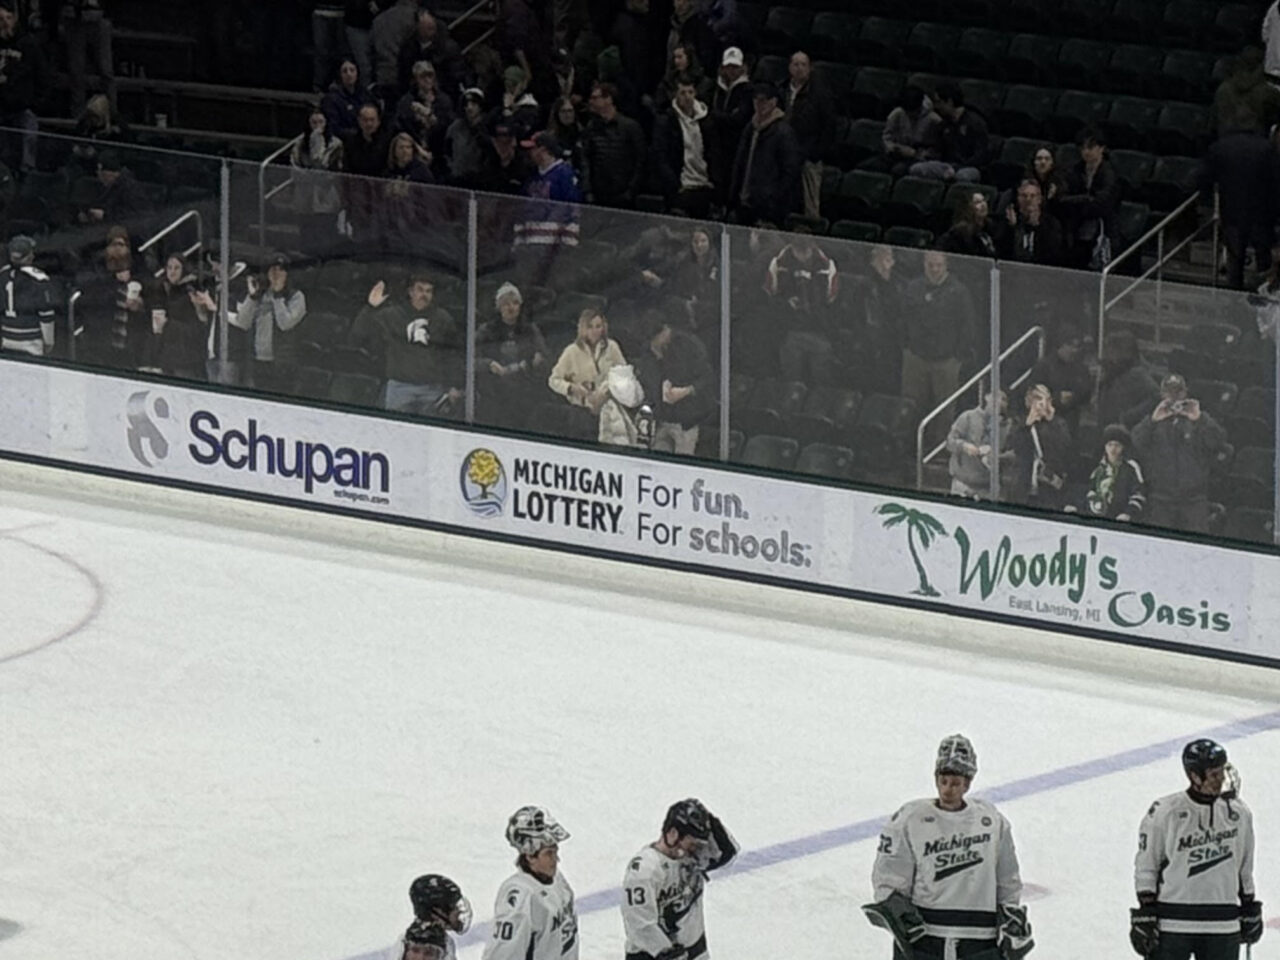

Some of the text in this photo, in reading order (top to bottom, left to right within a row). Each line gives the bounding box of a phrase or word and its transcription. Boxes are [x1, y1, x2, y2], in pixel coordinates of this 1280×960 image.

[188, 410, 389, 494] Schupan
[514, 458, 623, 498] MICHIGAN
[638, 475, 749, 520] For fun.
[513, 488, 623, 534] LOTTERY
[637, 513, 812, 568] For schools.
[954, 525, 1118, 604] Woody's
[1108, 591, 1231, 632] Oasis
[923, 833, 992, 857] Michigan
[1177, 828, 1238, 851] Michigan
[625, 886, 646, 907] 13
